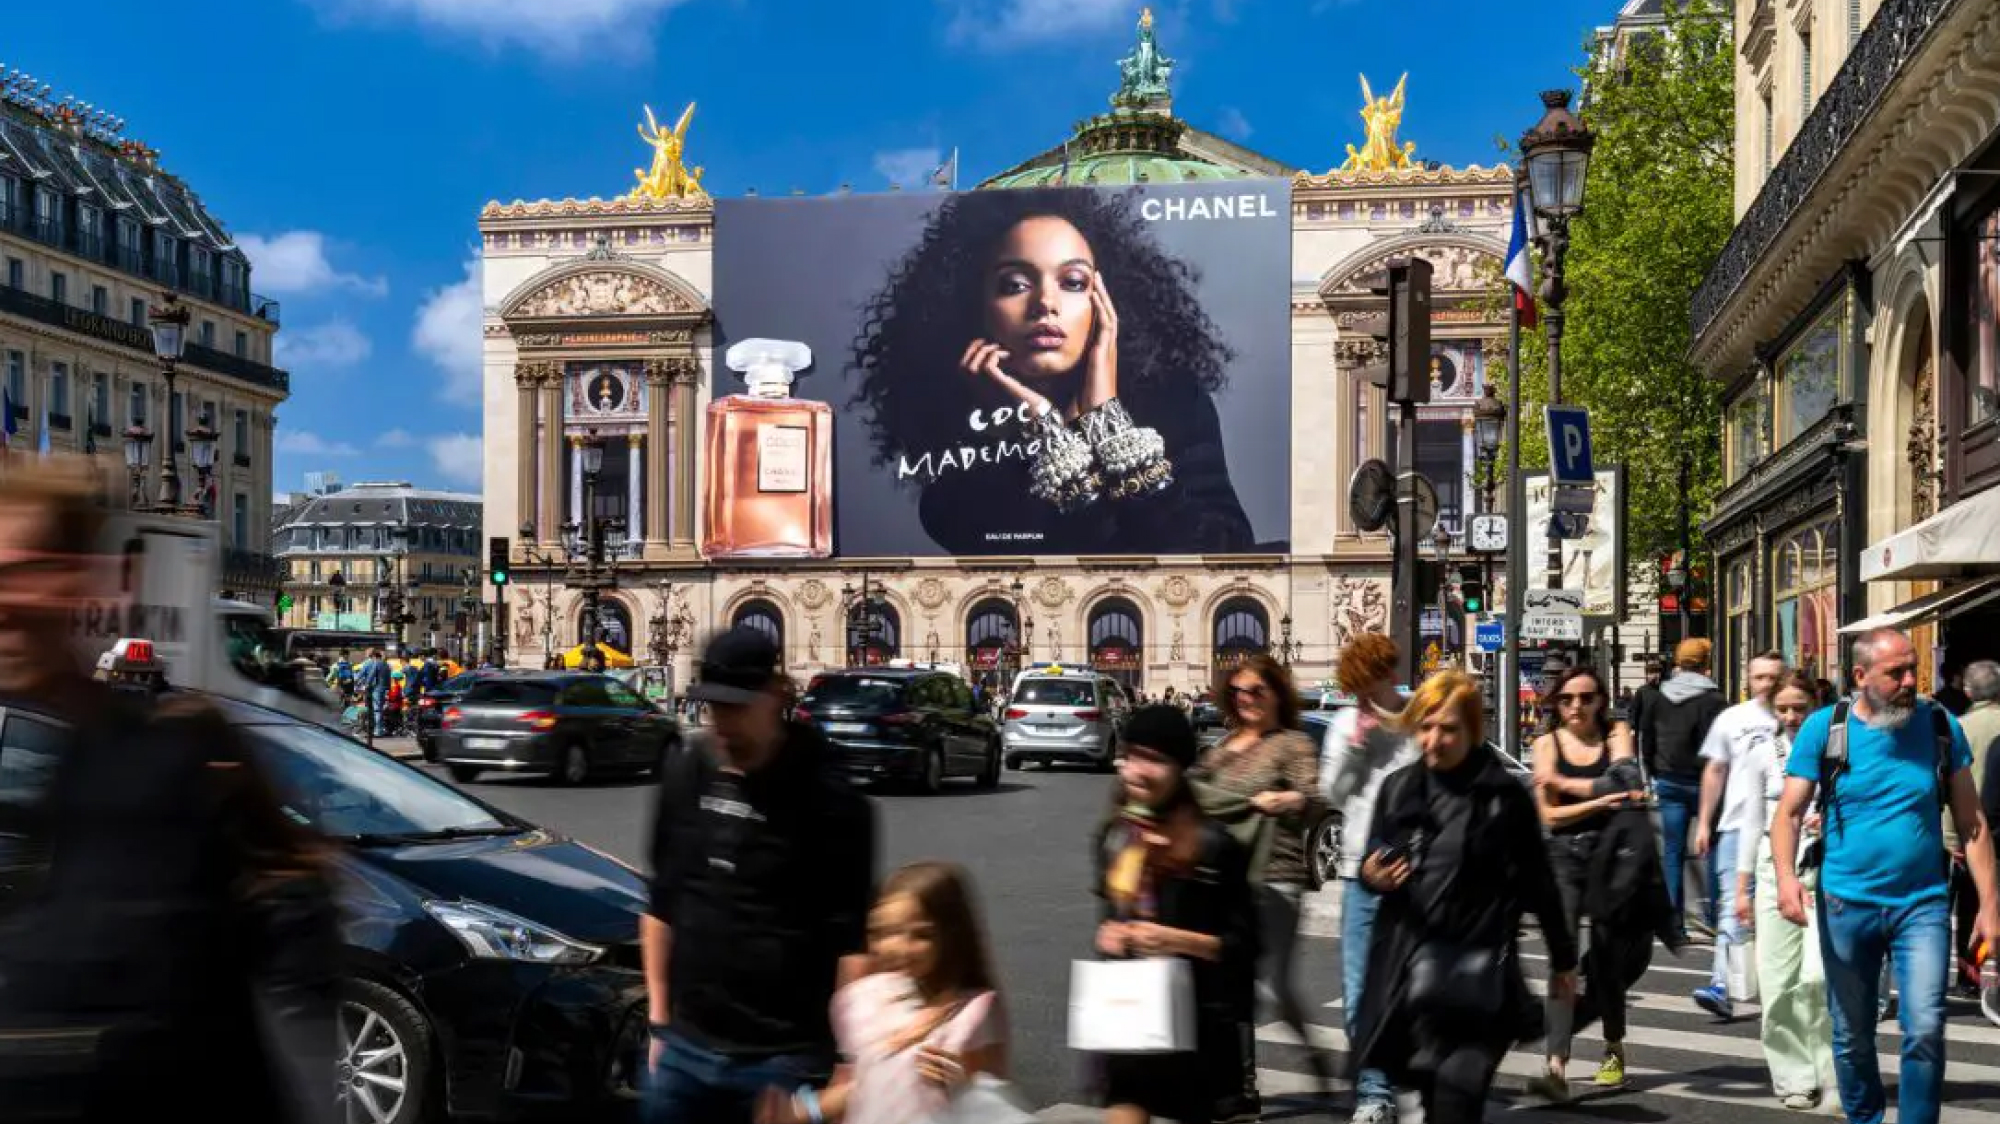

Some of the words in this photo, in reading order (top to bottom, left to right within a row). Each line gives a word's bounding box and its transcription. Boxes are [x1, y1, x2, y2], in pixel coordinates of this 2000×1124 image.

[1141, 194, 1277, 221] CHANEL
[1562, 424, 1583, 470] P
[985, 532, 1000, 540] EAU
[1002, 532, 1012, 540] DE
[1013, 532, 1044, 540] PARFUM
